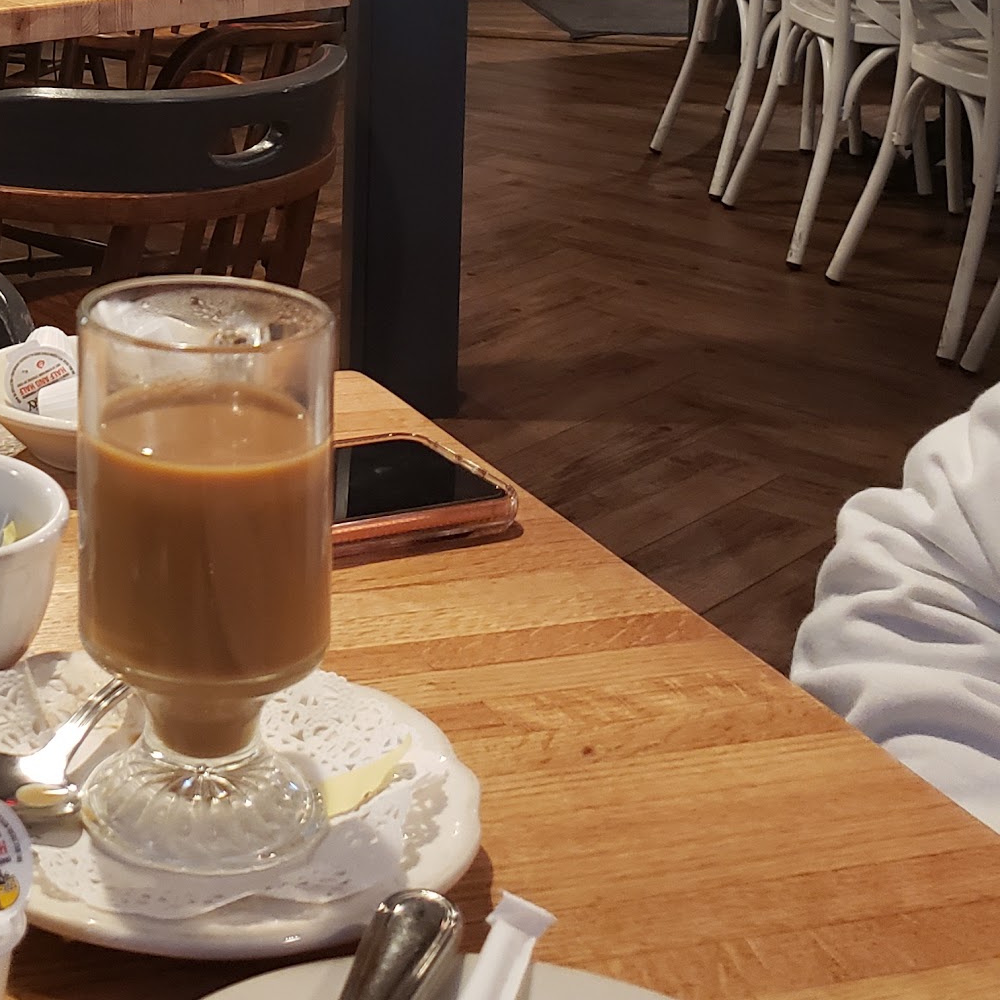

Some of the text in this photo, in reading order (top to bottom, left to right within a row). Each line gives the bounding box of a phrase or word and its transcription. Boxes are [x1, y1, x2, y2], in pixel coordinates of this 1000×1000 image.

[50, 366, 67, 380] HALF
[34, 376, 50, 388] AND
[19, 383, 36, 396] HALF
